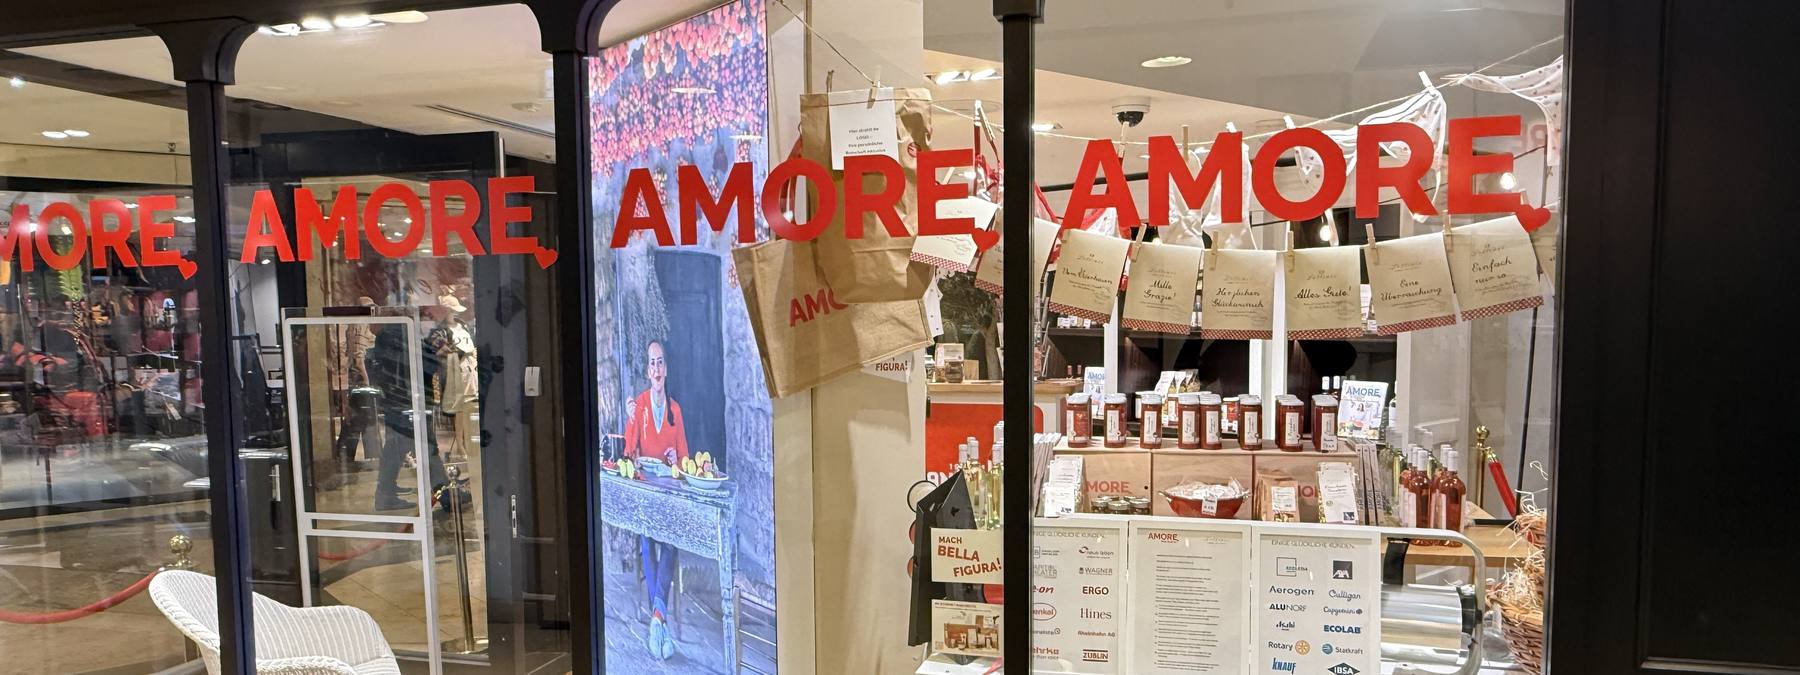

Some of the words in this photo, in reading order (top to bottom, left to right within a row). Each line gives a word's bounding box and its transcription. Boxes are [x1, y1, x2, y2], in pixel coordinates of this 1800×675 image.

[1062, 115, 1523, 230] AMORE
[610, 149, 976, 248] AMORE
[240, 175, 538, 264] AMORE
[875, 360, 908, 372] FIGURA!
[1345, 387, 1381, 397] AMORE
[938, 536, 962, 545] MACH
[1148, 532, 1178, 541] AMORE
[937, 545, 980, 562] BELLA
[953, 557, 1002, 577] FIGURA!
[1333, 569, 1350, 578] AXA
[1082, 586, 1109, 595] ERGO
[1269, 585, 1314, 596] Aerogen
[1328, 589, 1361, 602] Culligan
[1269, 603, 1307, 611] ALUNORF
[1080, 607, 1112, 619] Hines
[1323, 625, 1361, 634] ECOLAB
[1268, 641, 1293, 651] Rotary
[1335, 646, 1363, 655] Statkraft
[1333, 666, 1354, 675] IBSA
